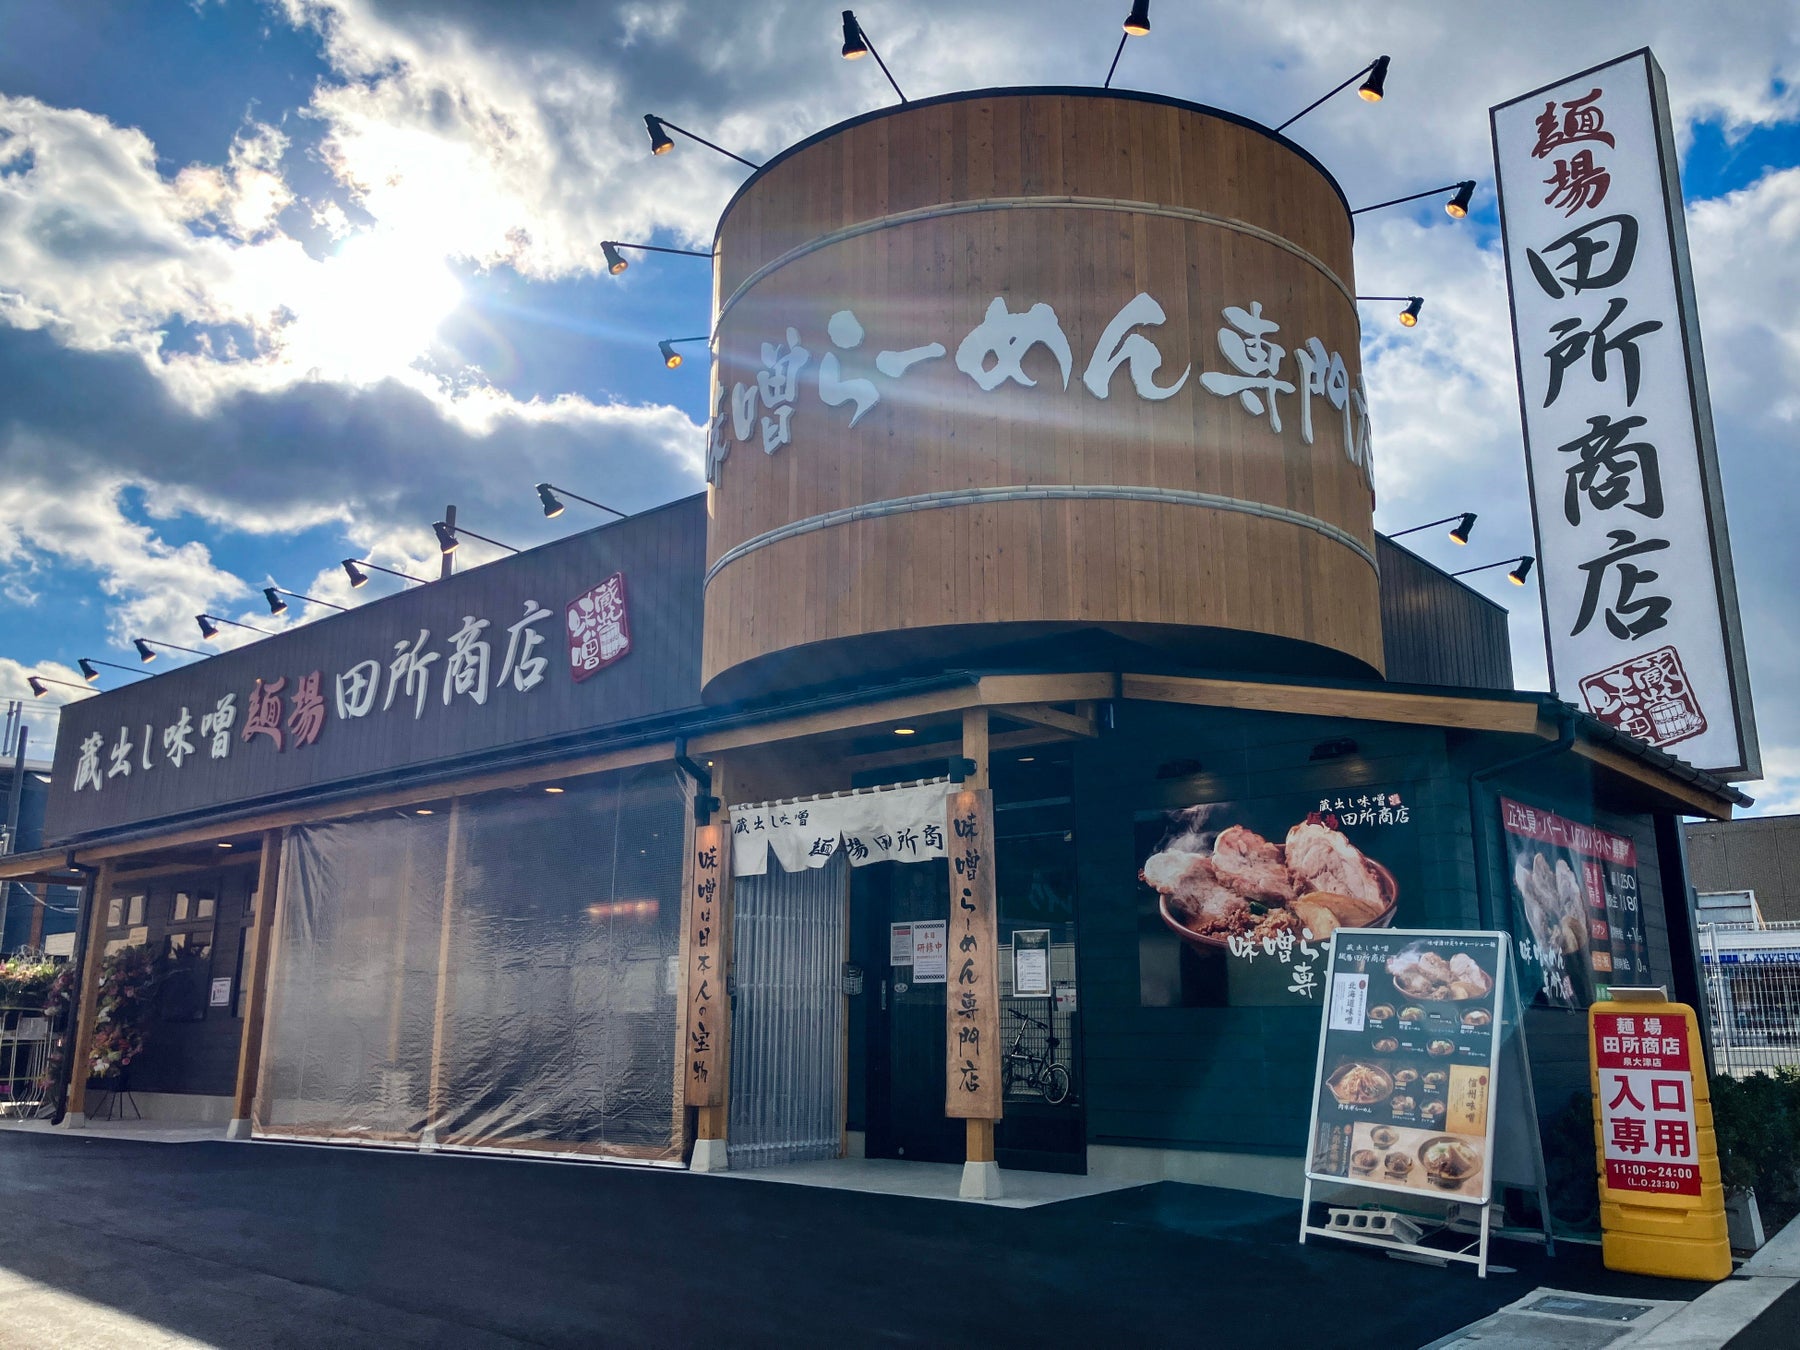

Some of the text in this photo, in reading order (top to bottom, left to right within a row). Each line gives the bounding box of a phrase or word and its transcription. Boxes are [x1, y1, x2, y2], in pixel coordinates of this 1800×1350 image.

[954, 812, 981, 1093] 味噌らーめん専門店
[1227, 928, 1331, 964] 味噌ら
[1616, 1017, 1662, 1035] 麺場
[1603, 1036, 1680, 1056] 田所商店
[1608, 1075, 1686, 1112] 入口
[1610, 1116, 1691, 1158] 専用
